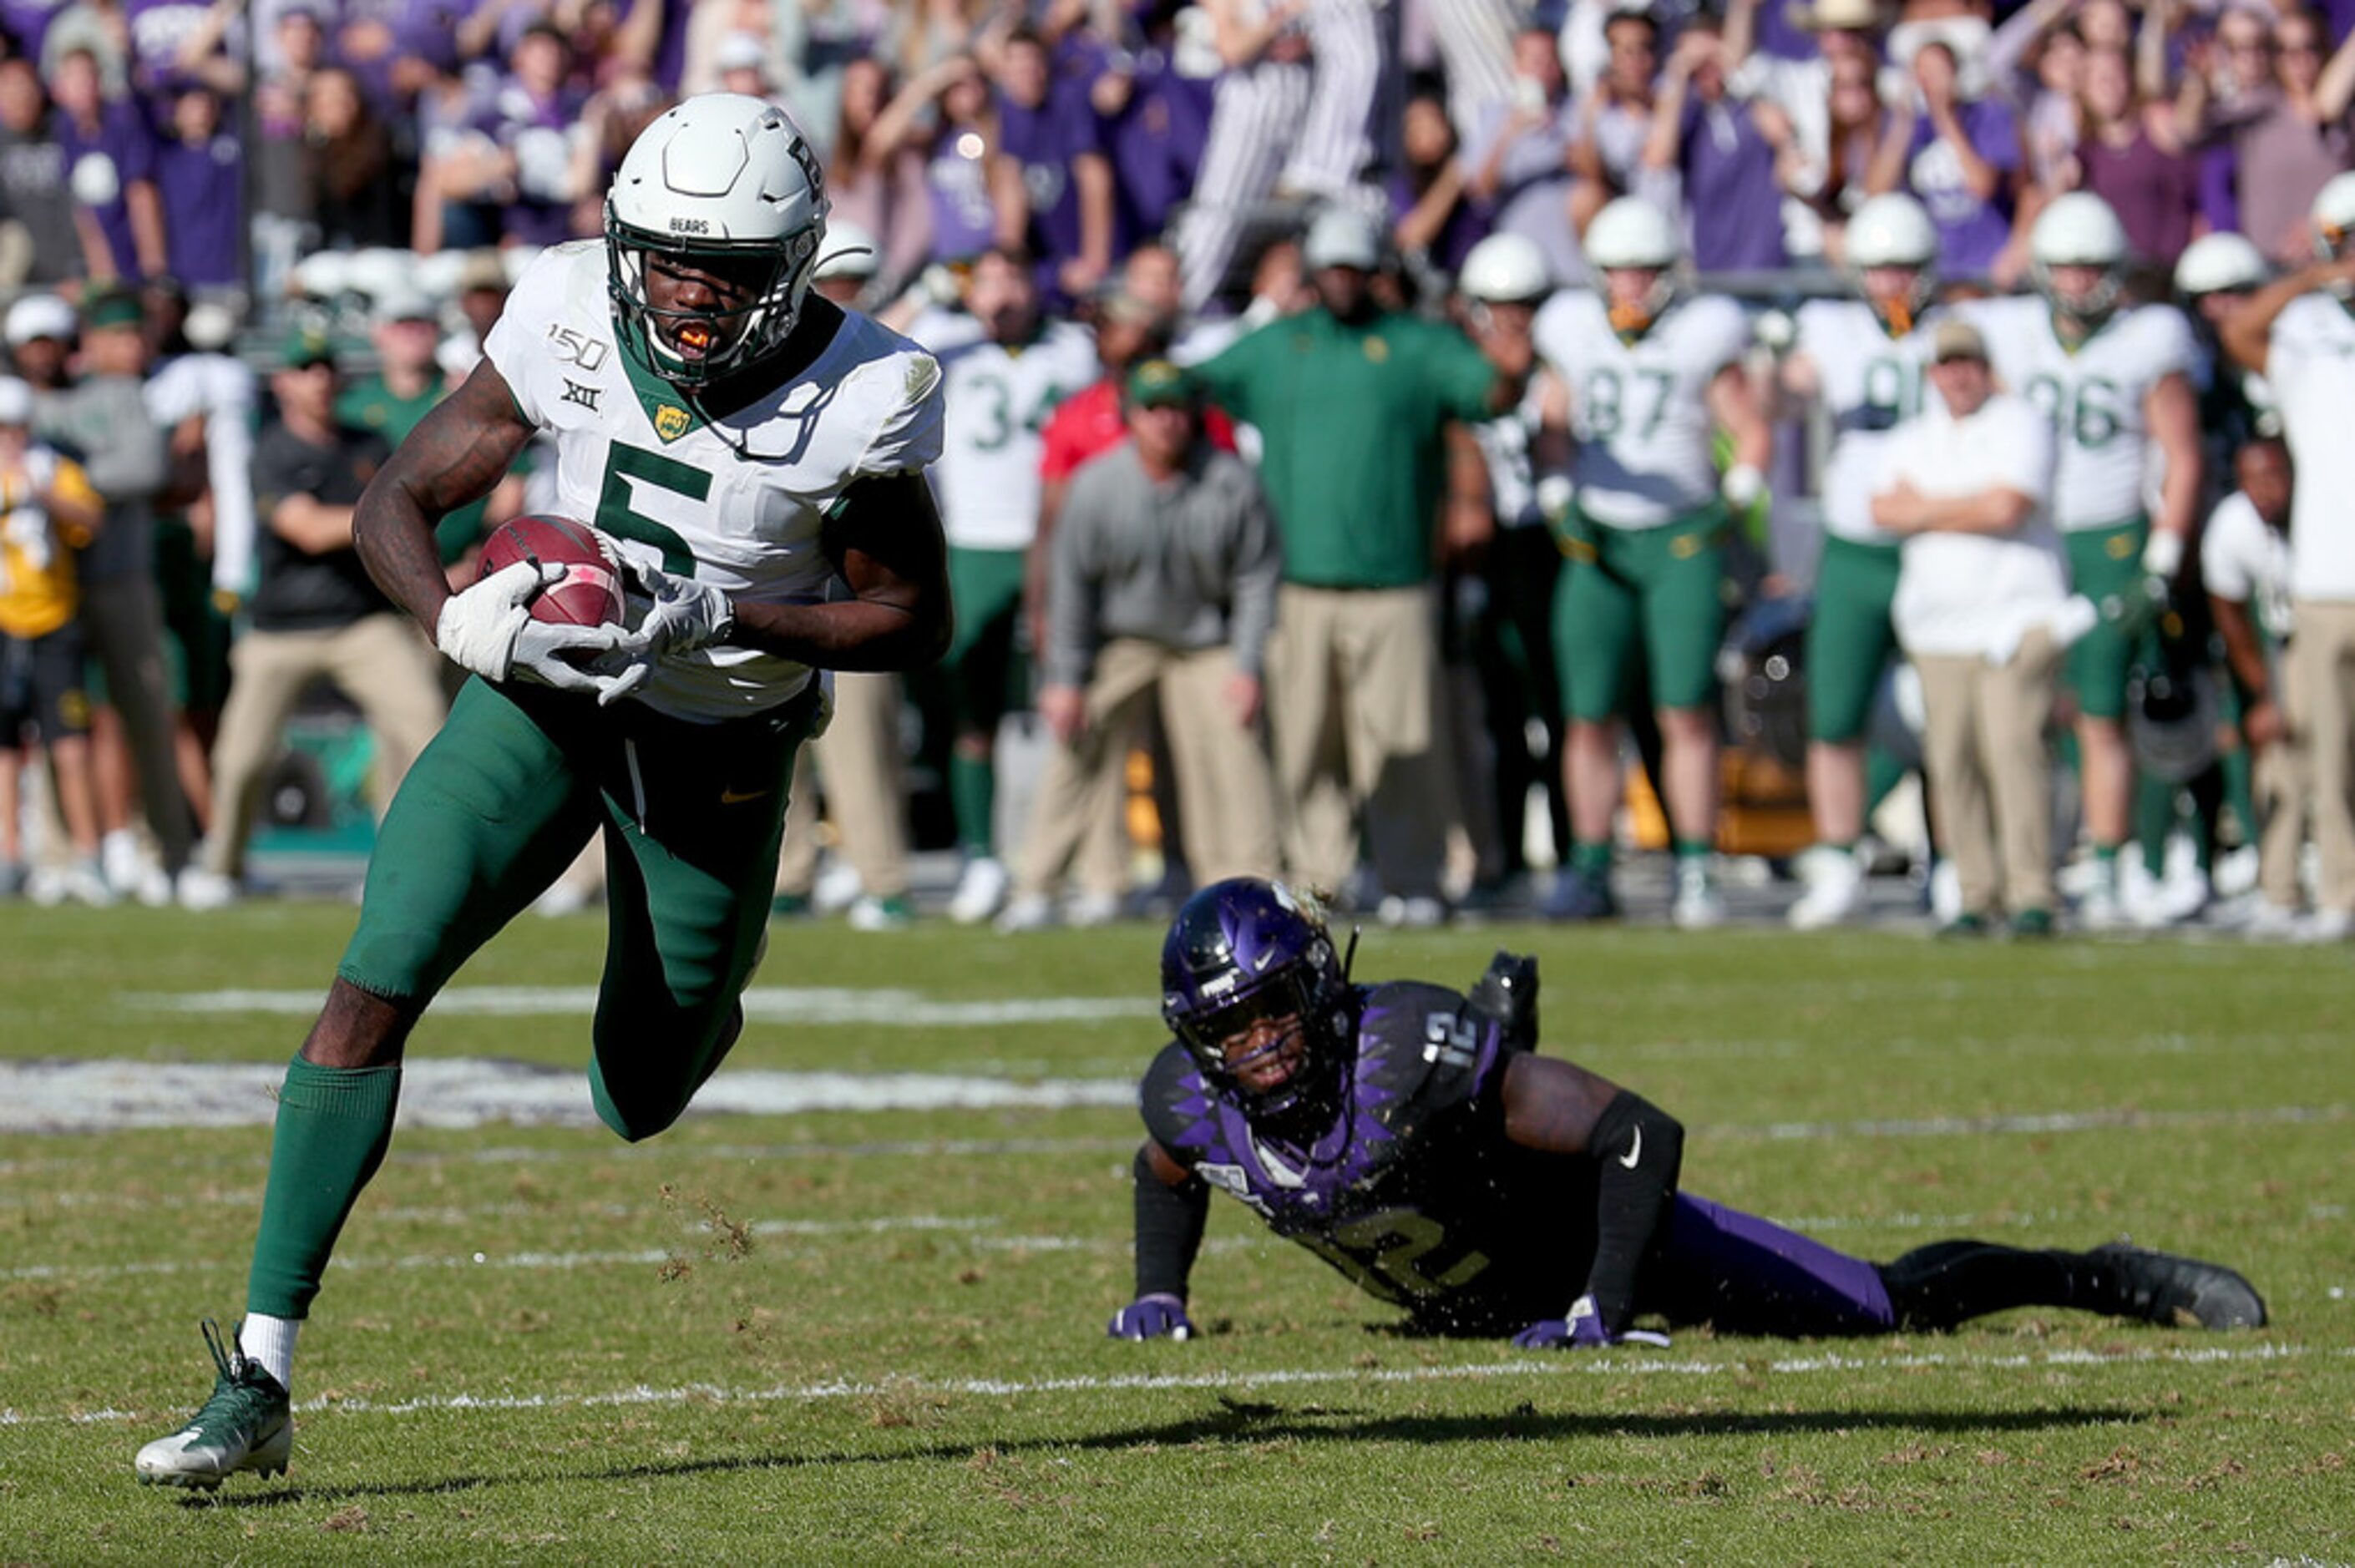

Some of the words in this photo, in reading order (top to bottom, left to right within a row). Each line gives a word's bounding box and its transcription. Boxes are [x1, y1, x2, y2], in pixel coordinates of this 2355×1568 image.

[669, 217, 709, 235] BEARS
[548, 322, 612, 373] 150
[560, 377, 602, 413] XII
[1586, 366, 1674, 442] 87
[594, 438, 714, 580] 5
[1422, 1011, 1477, 1068] 12
